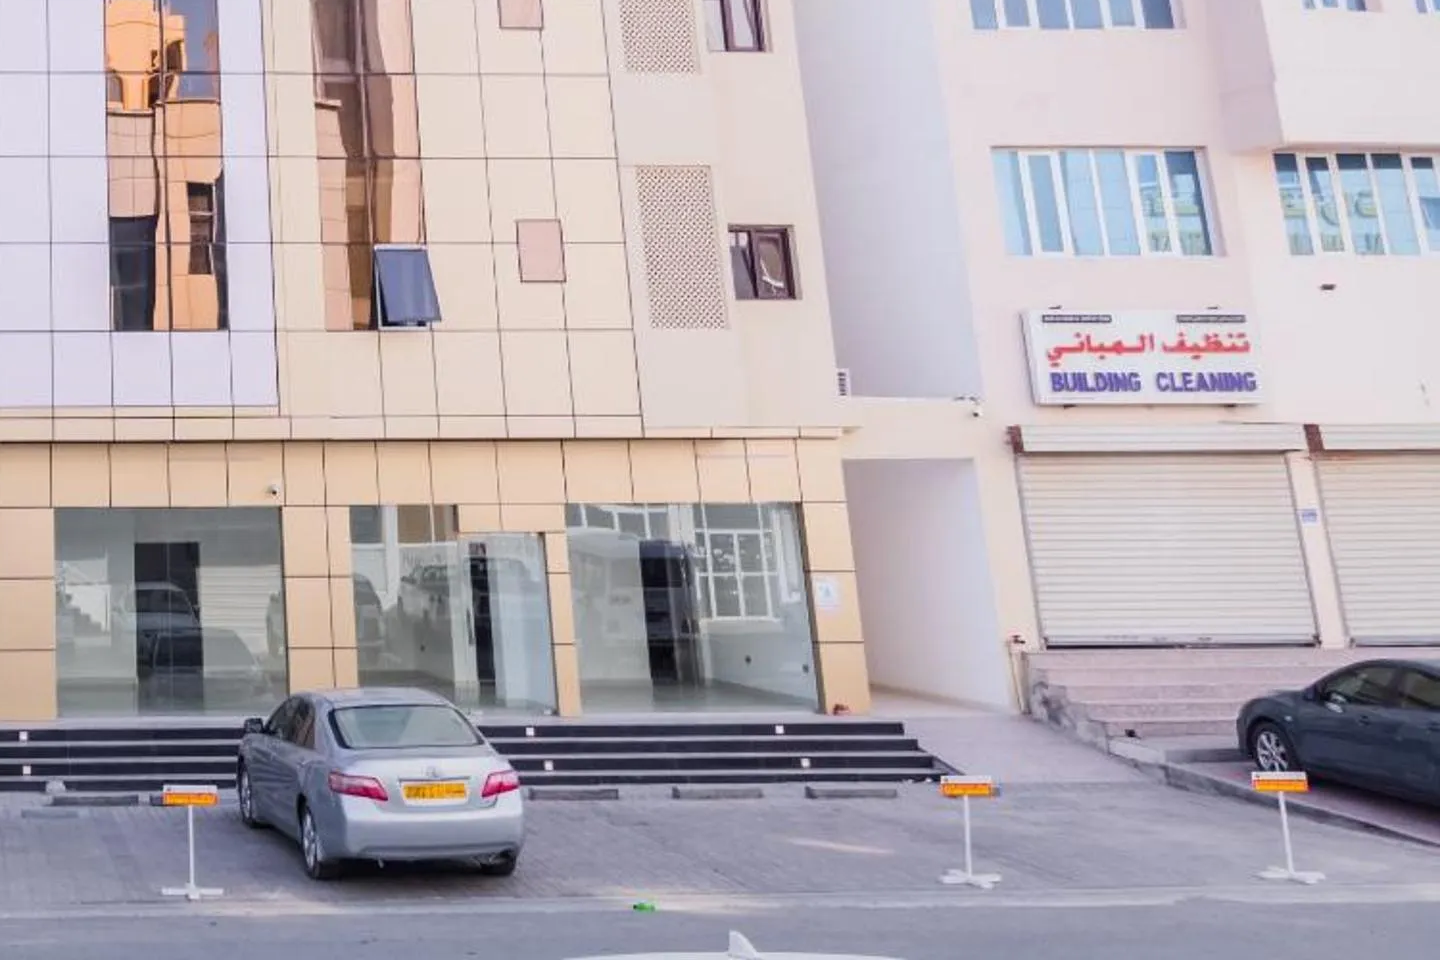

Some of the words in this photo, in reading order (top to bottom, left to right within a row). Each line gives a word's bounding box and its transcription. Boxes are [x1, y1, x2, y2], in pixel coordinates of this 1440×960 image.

[1046, 332, 1155, 367] المباني
[1161, 332, 1251, 359] تنظيف
[1050, 371, 1141, 392] BUILDING
[1156, 371, 1257, 392] CLEANING
